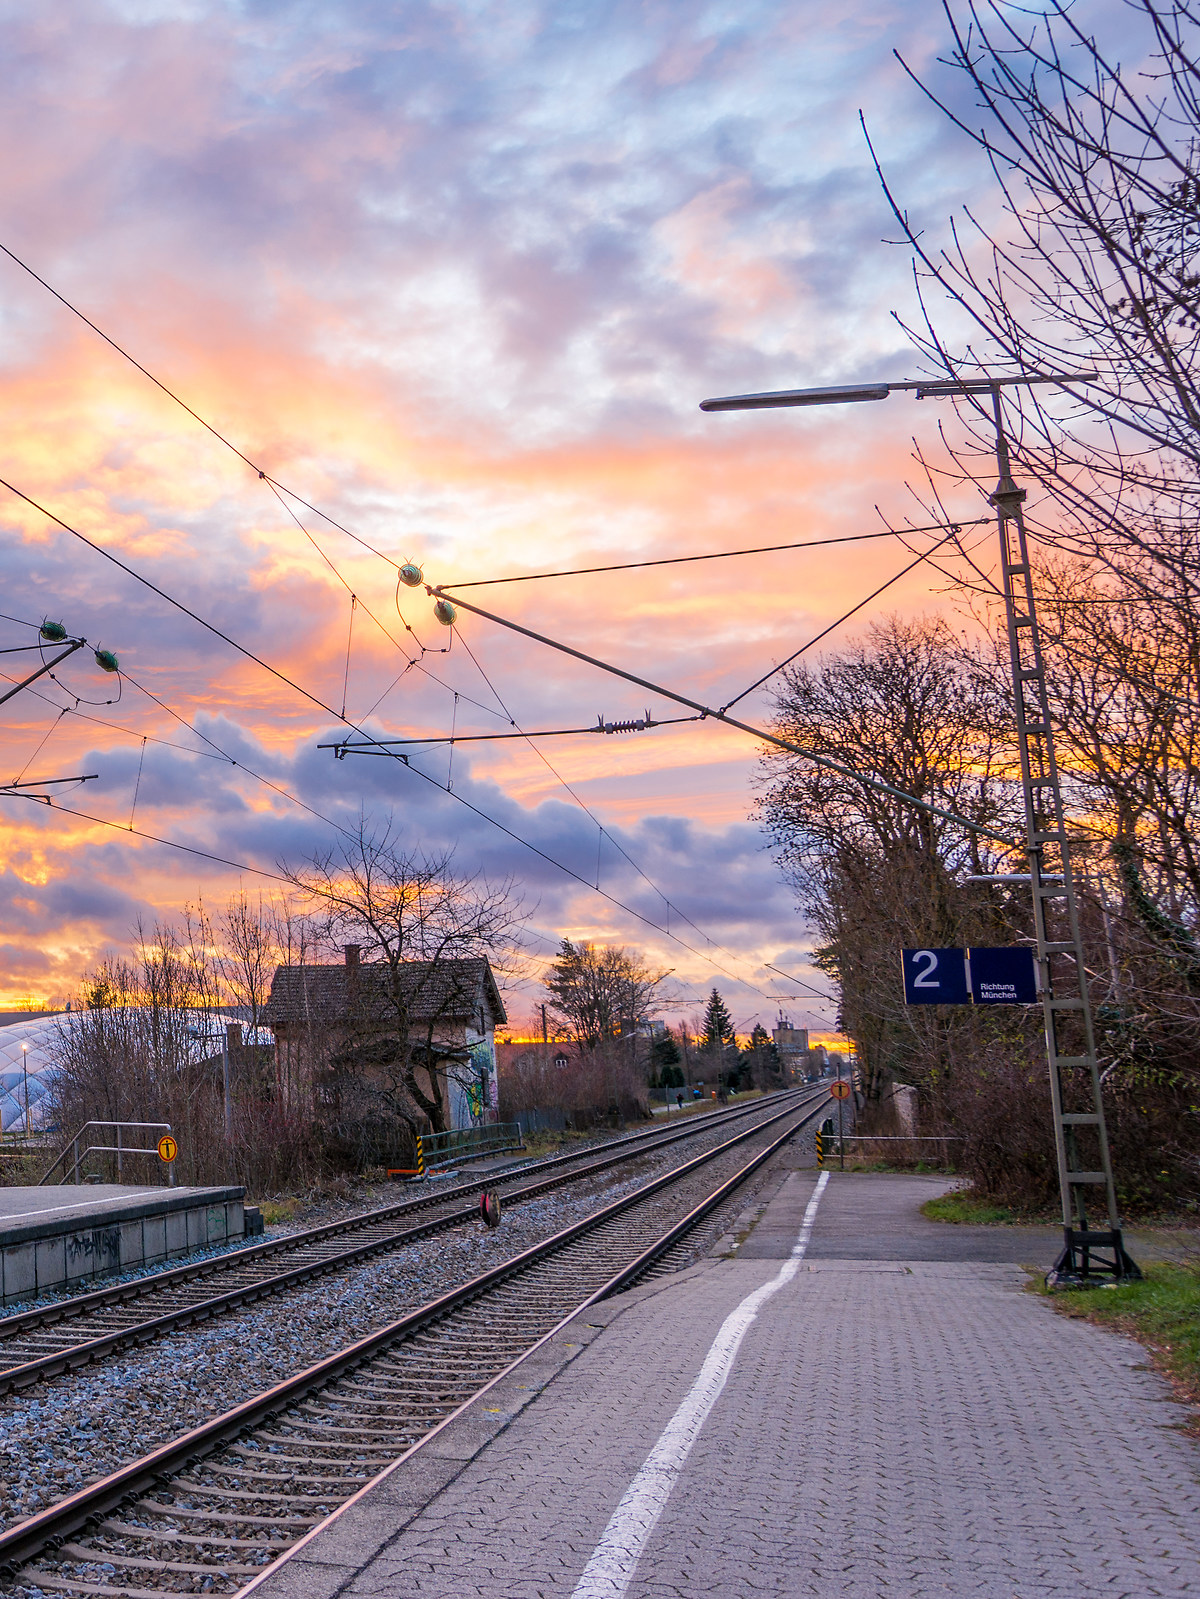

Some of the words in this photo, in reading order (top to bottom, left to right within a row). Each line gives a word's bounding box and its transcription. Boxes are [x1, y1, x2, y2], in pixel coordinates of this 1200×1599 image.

[912, 950, 940, 987] 2
[980, 983, 1015, 991] Richtung
[981, 991, 1017, 999] München
